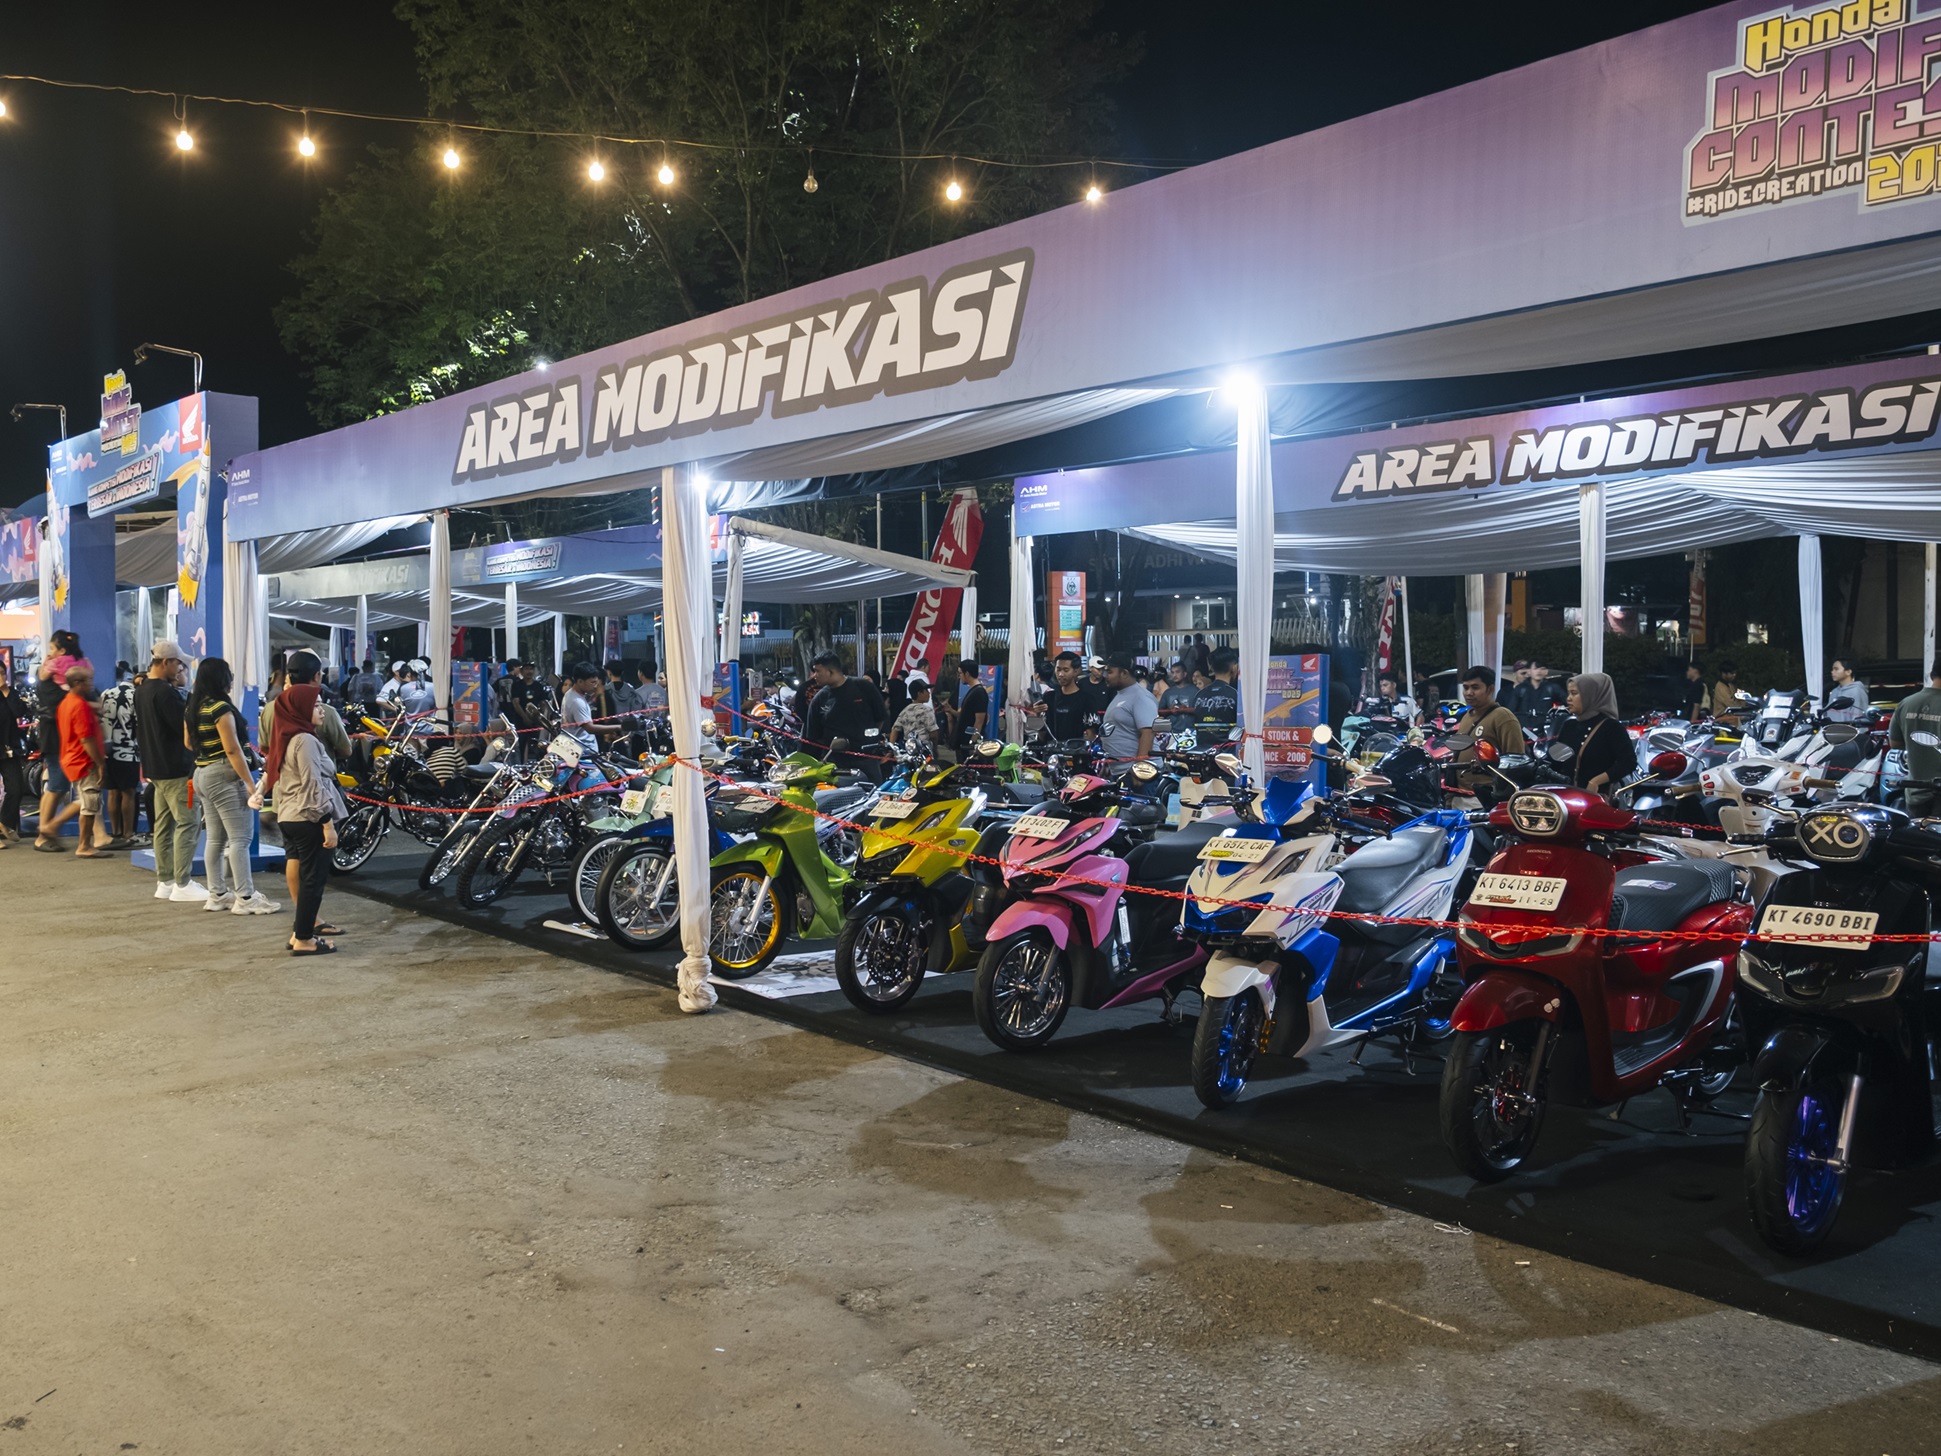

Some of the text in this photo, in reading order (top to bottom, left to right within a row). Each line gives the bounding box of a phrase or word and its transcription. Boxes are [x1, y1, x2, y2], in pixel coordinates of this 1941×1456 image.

[1744, 0, 1900, 72] Honda
[1867, 144, 1941, 203] 20
[1687, 161, 1863, 214] #RIDECREATION
[456, 261, 1026, 474] AREA MODIFIKASI
[1338, 381, 1941, 495] AREA MODIFIKASI
[231, 468, 250, 481] AHM
[1020, 484, 1048, 494] AHM
[902, 542, 955, 673] HOND
[1268, 731, 1291, 741] STOCK
[1292, 731, 1299, 741] &
[1475, 725, 1484, 737] G
[1287, 752, 1306, 762] 2006
[1019, 817, 1031, 825] KT
[1809, 821, 1864, 849] XO
[1207, 840, 1272, 850] KT 6512 CAF
[1479, 877, 1561, 893] KT 6413 BBF
[1767, 909, 1872, 930] KT 4690 BBI
